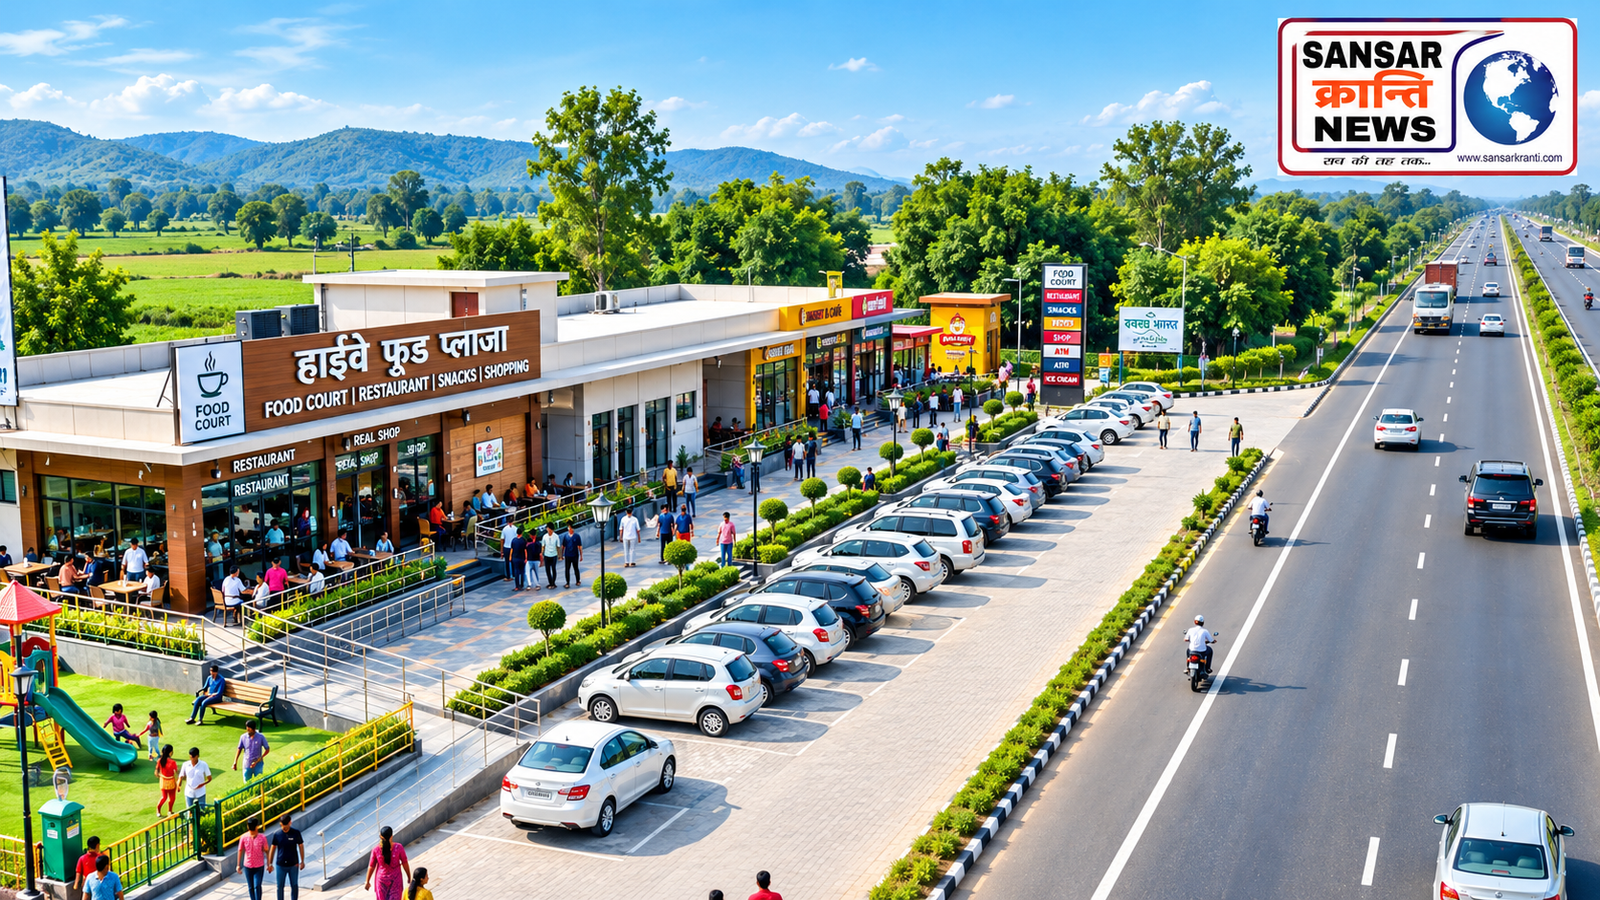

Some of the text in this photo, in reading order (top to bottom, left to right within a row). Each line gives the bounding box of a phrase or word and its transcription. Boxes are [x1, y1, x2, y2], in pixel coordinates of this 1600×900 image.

[294, 325, 510, 386] हाईवे फूड प्लाजा
[264, 397, 303, 419] FOOD
[305, 388, 349, 412] COURT
[358, 375, 430, 403] RESTAURANT
[437, 367, 478, 389] SNACKS
[483, 359, 530, 381] SHOPPING
[195, 401, 230, 417] FOOD
[195, 415, 232, 431] COURT
[353, 426, 401, 447] REAL SHOP
[232, 448, 296, 474] RESTAURANT
[234, 472, 290, 498] RESTAURANT
